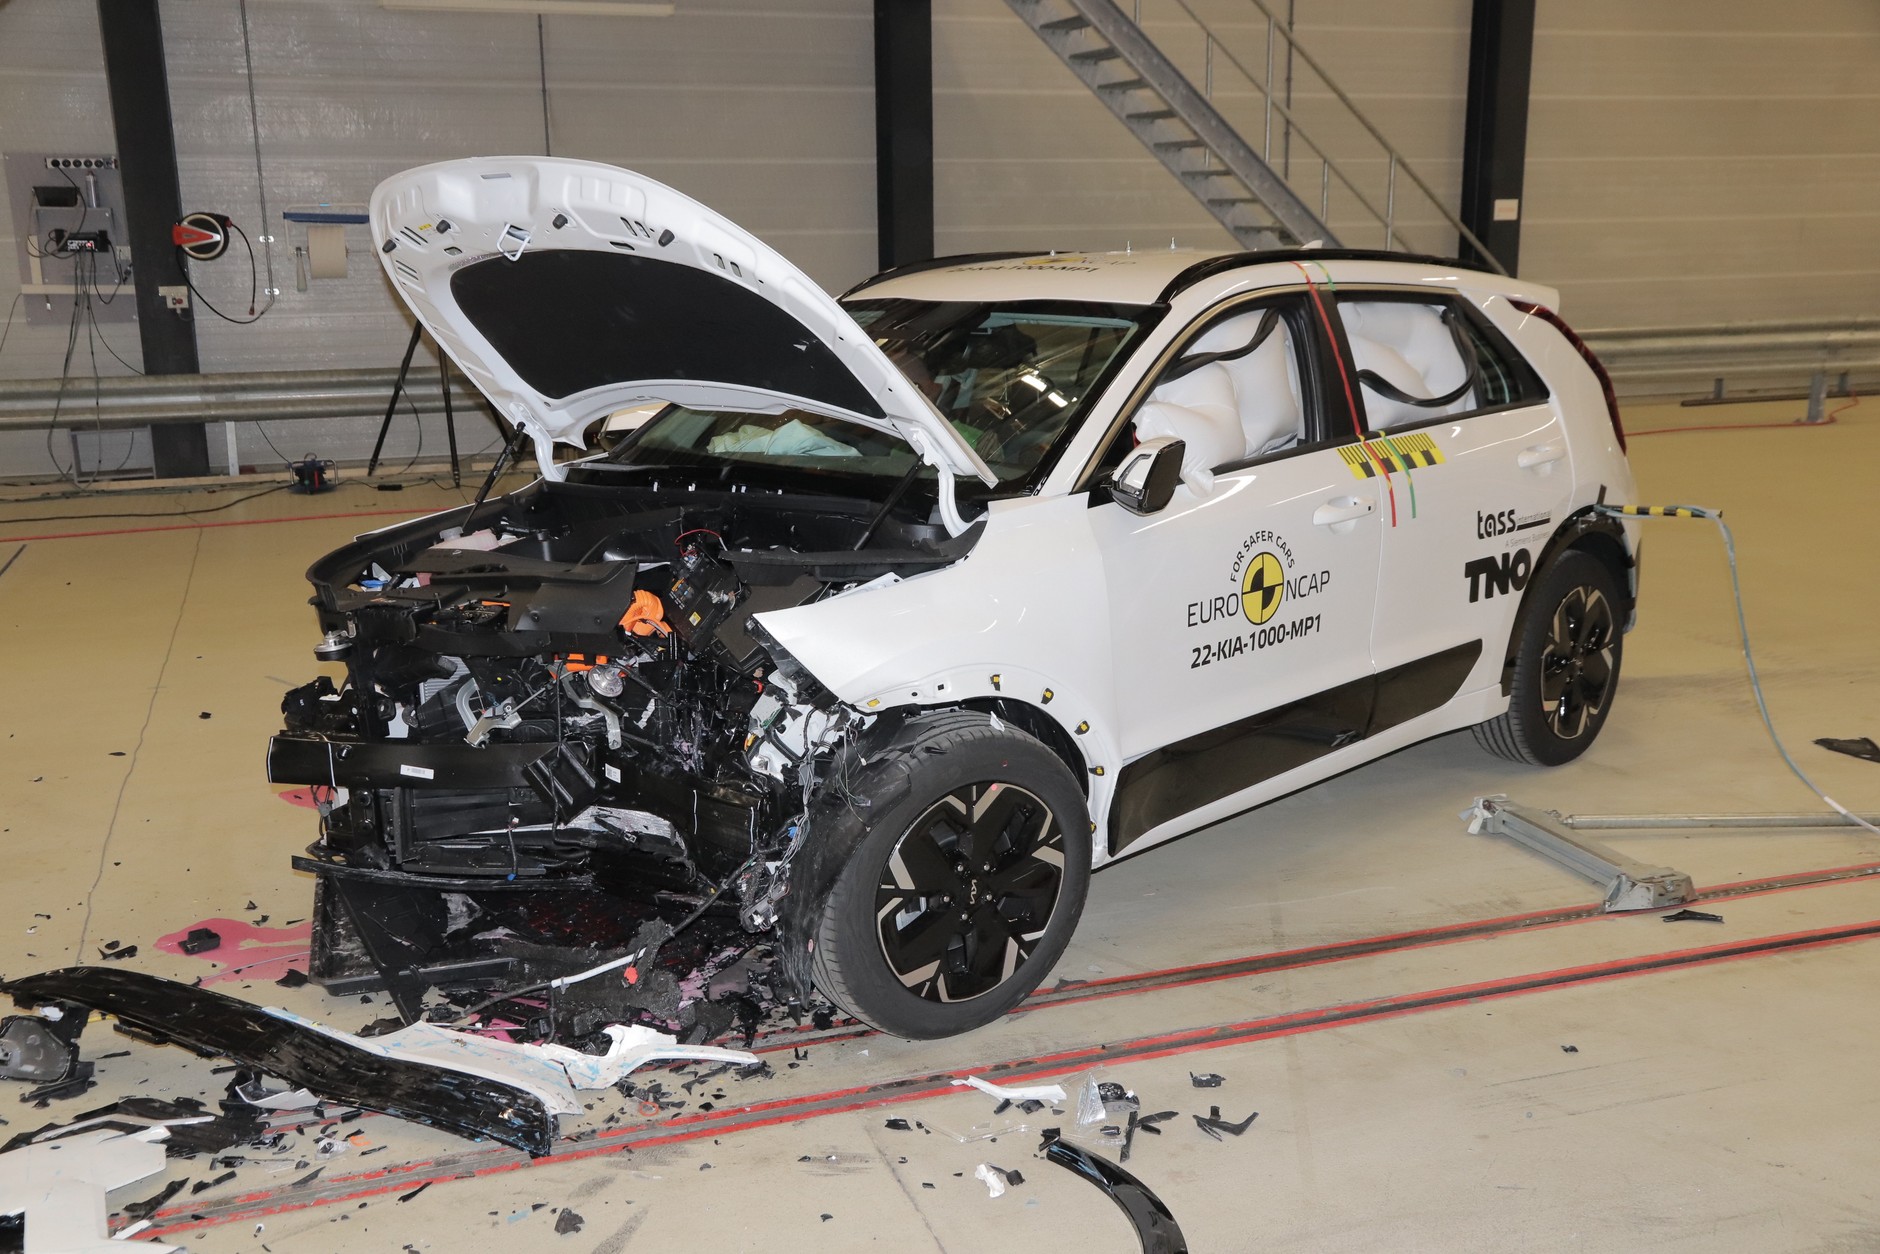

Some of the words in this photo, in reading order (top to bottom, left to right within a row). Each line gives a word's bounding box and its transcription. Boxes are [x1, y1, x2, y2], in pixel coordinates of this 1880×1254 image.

[1477, 509, 1516, 540] tass
[1230, 551, 1245, 582] FOR
[1243, 530, 1274, 552] SAFER
[1275, 536, 1295, 568] CARS
[1464, 548, 1531, 603] TNO
[1187, 593, 1239, 627] EURO
[1286, 570, 1331, 601] NCAP
[1190, 613, 1321, 669] 22-KIA-1000-MP1
